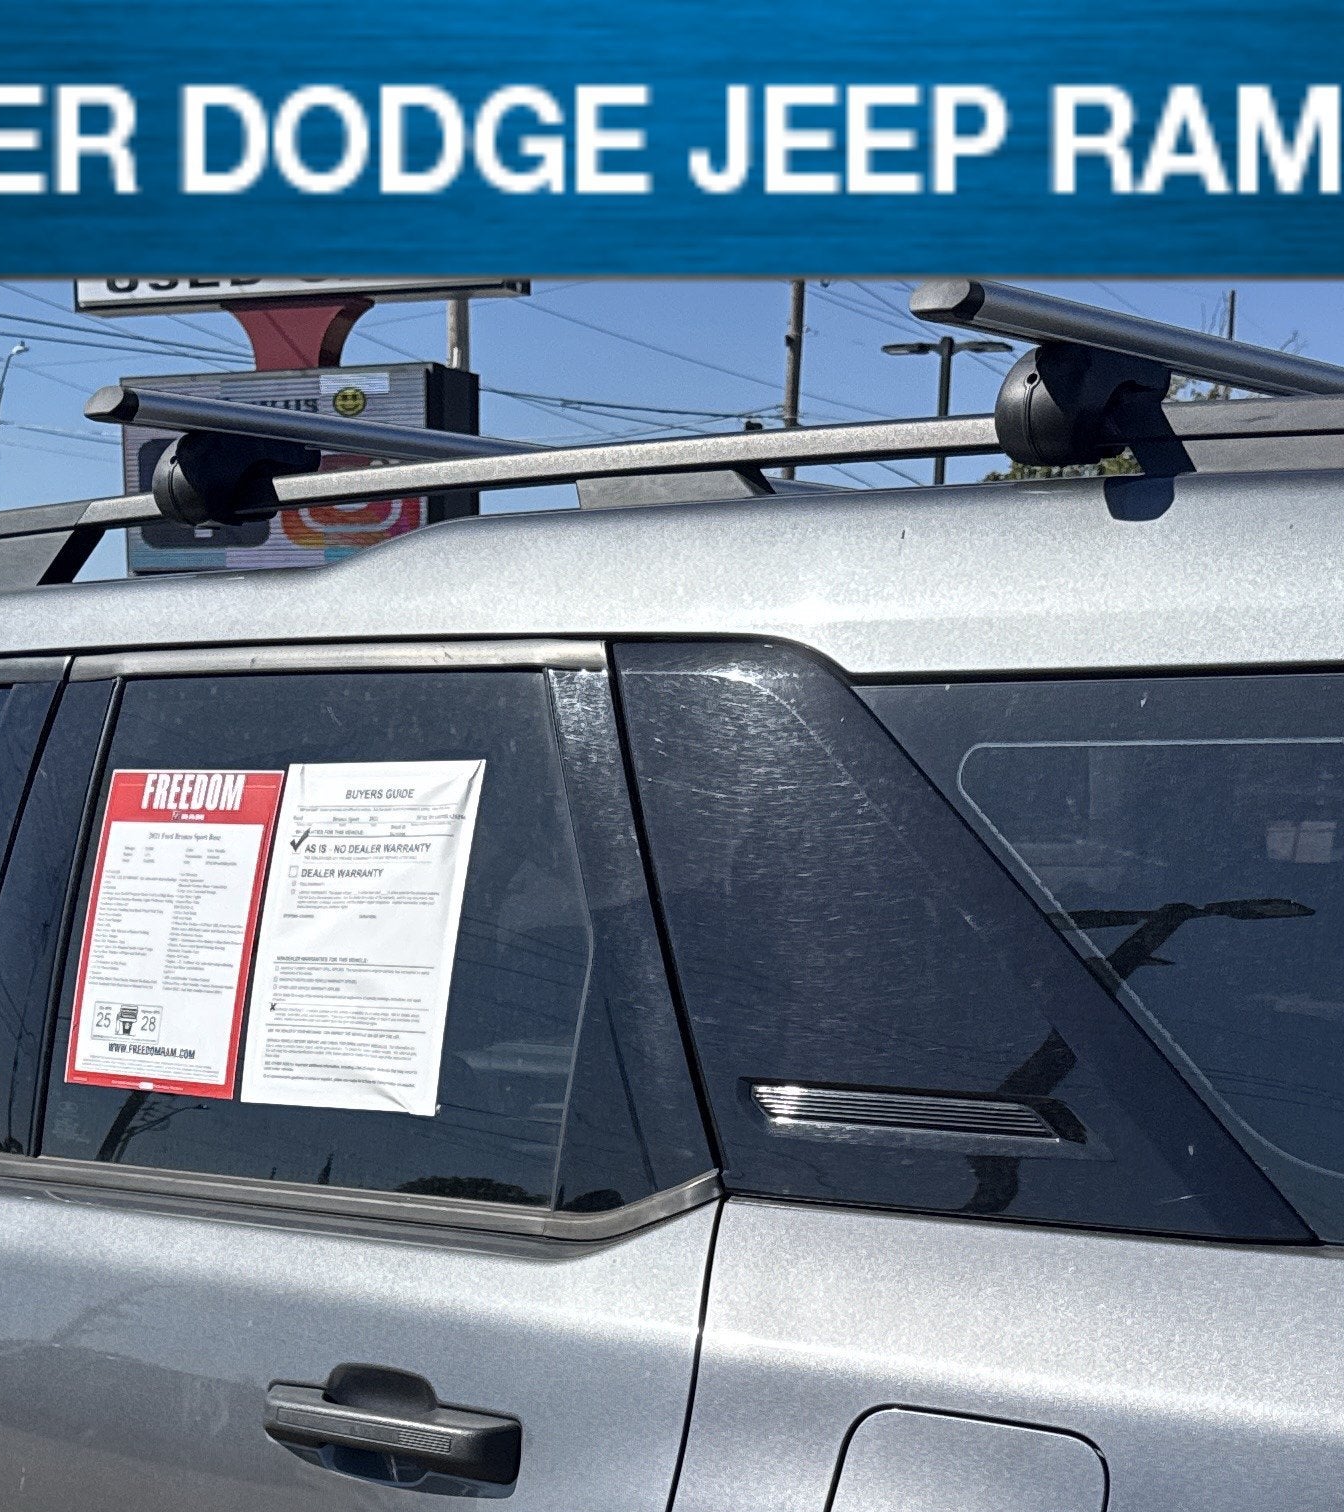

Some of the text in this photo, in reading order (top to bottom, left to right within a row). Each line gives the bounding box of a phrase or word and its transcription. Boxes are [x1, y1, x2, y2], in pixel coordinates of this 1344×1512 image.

[141, 773, 246, 811] FREEDOM
[345, 788, 415, 799] BUYERS GUIDE
[305, 844, 317, 854] AS
[318, 844, 327, 853] IS
[334, 844, 345, 854] NO
[348, 844, 381, 854] DEALER
[383, 843, 431, 853] WARRANTY
[301, 868, 384, 878] DEALER WARRANTY
[96, 1012, 111, 1028] 25
[141, 1016, 156, 1032] 28
